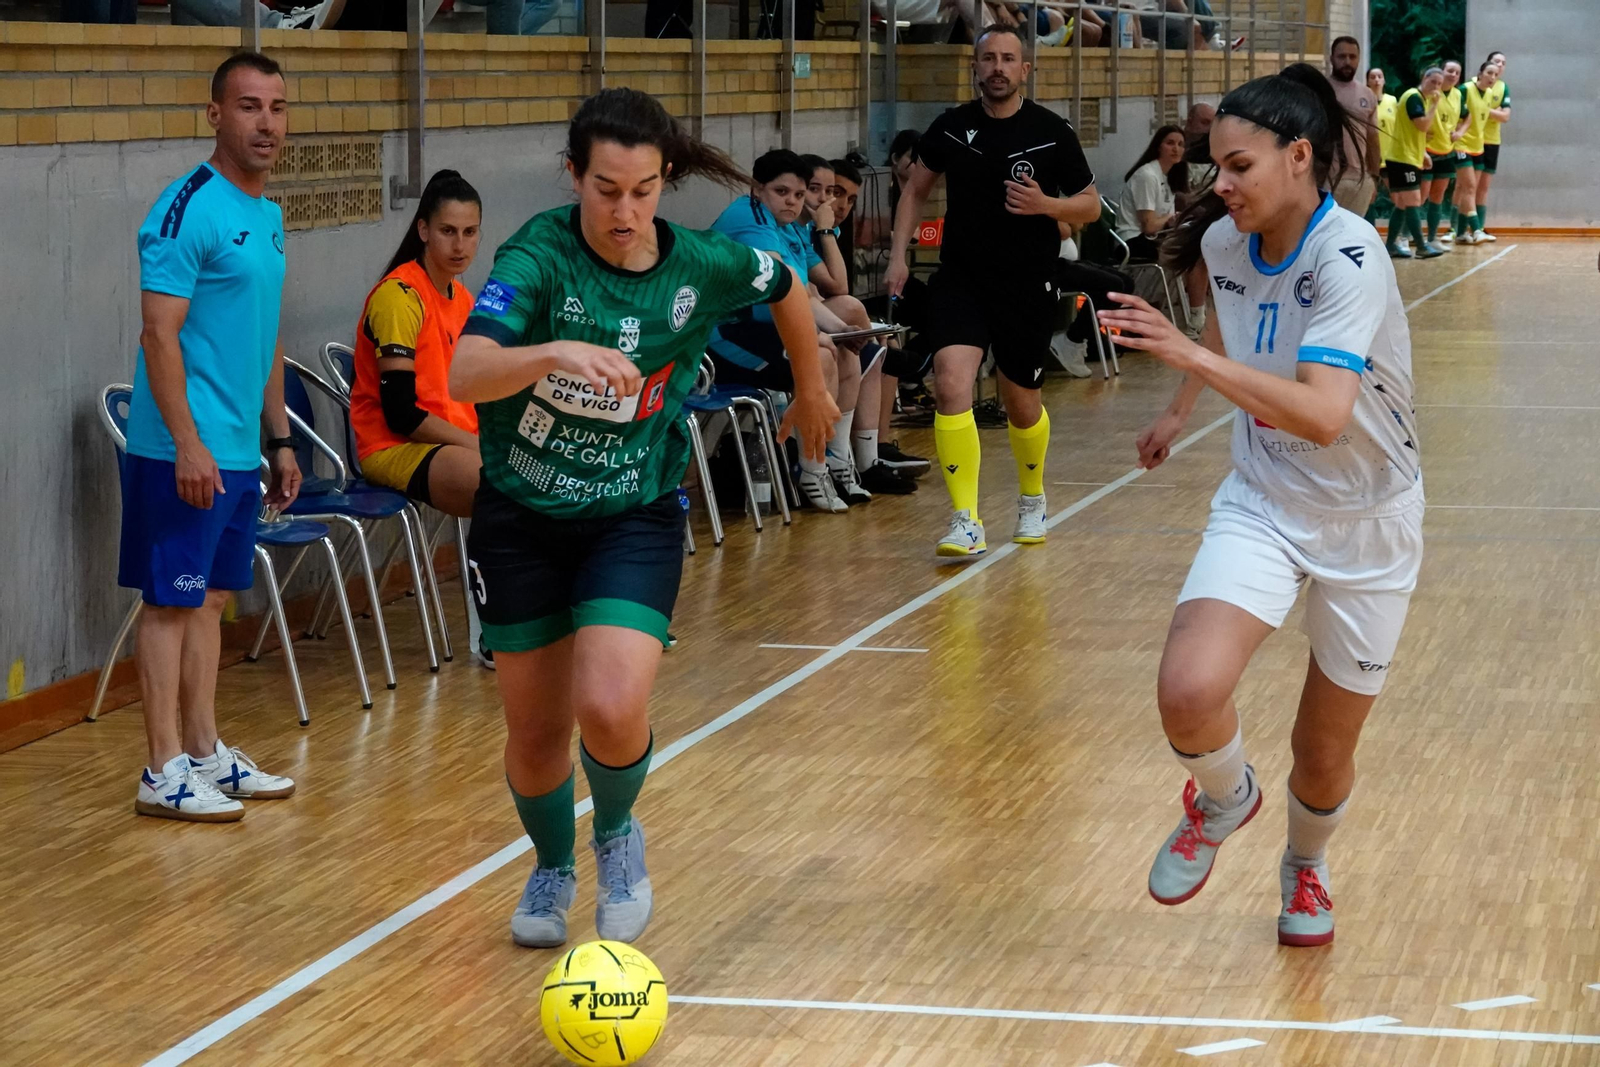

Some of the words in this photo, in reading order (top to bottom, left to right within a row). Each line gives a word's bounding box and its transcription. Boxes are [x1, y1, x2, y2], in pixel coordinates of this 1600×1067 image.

[1404, 171, 1416, 183] 16
[551, 388, 575, 405] DE
[581, 397, 621, 412] VIGO
[558, 425, 624, 449] XUNTA
[550, 438, 575, 460] DE
